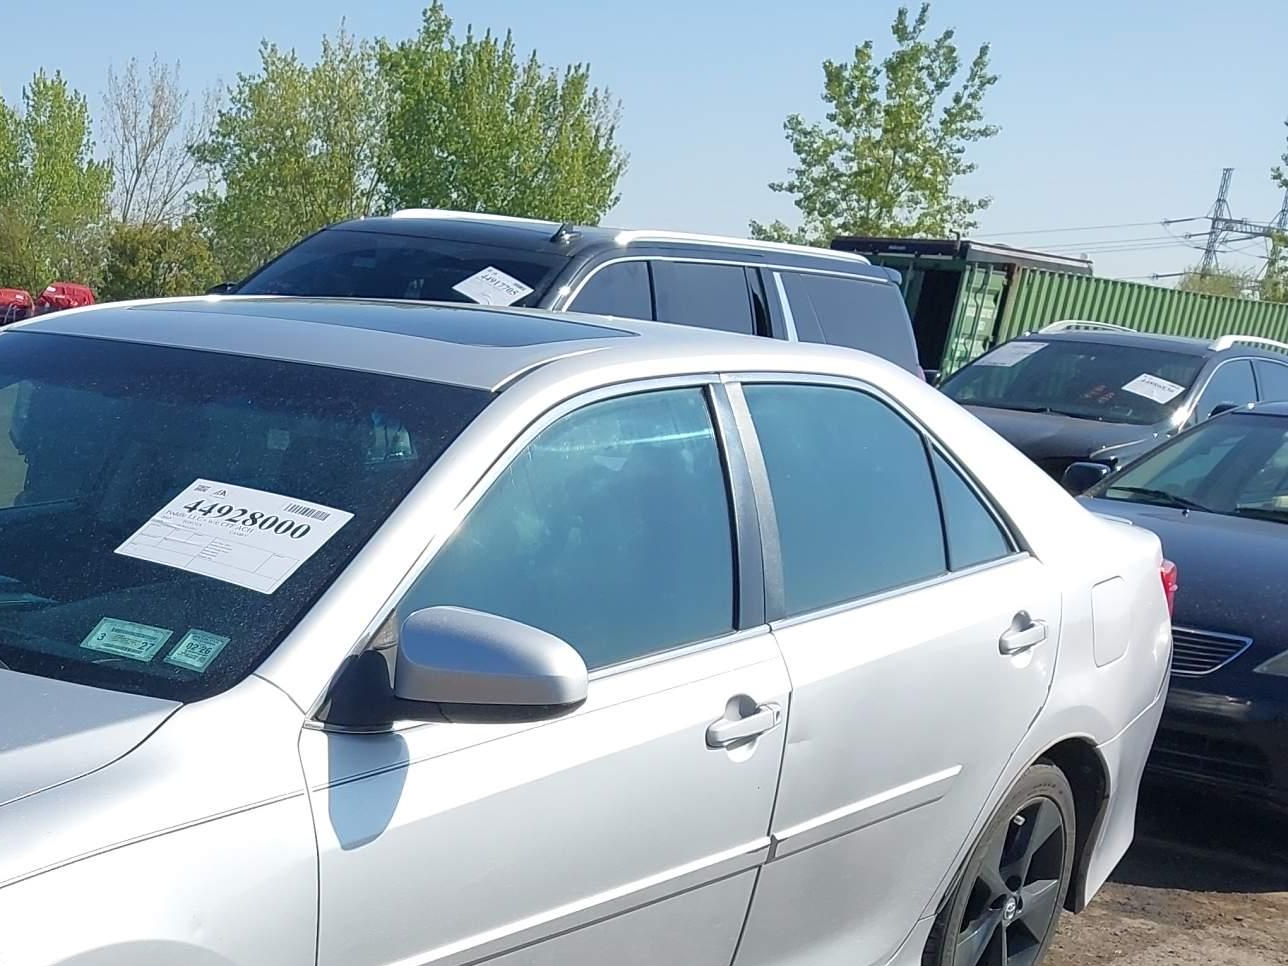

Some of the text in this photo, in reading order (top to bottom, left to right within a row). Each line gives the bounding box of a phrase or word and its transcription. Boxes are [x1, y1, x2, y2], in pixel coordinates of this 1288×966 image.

[183, 498, 311, 540] 44928000
[96, 632, 107, 641] 3
[138, 641, 155, 652] 27
